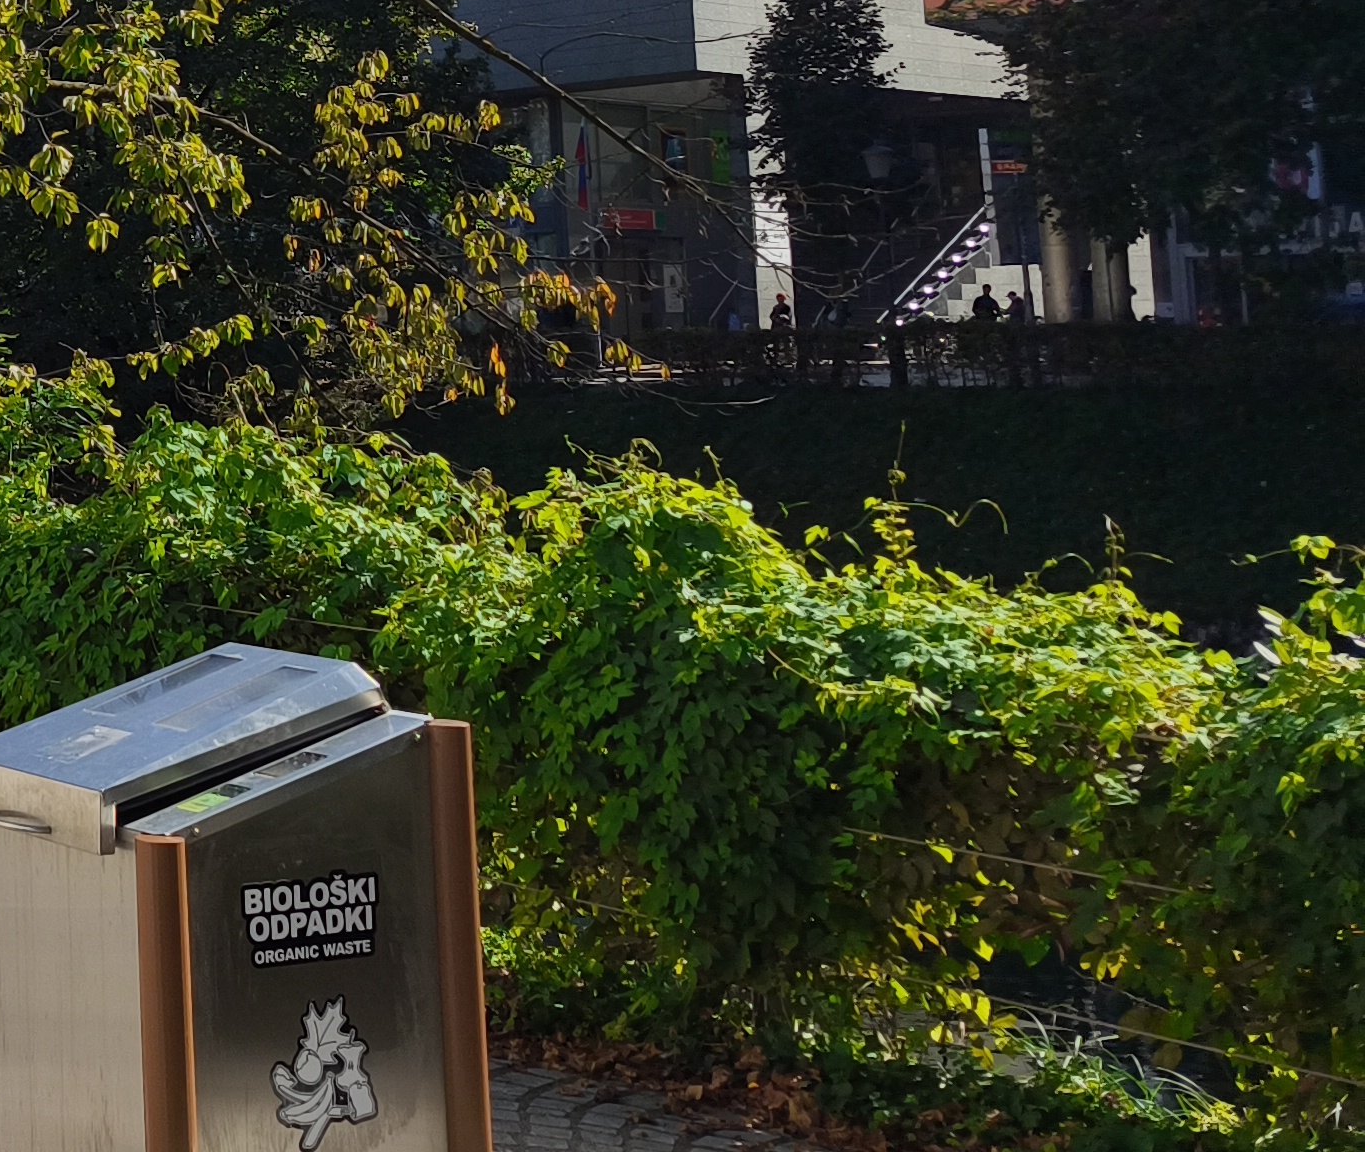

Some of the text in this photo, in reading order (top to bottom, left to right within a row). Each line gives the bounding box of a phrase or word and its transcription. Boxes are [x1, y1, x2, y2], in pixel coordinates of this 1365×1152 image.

[244, 874, 376, 915] BIOLOŠKI
[249, 905, 373, 943] ODPADKI
[254, 939, 372, 965] ORGANIC WASTE
